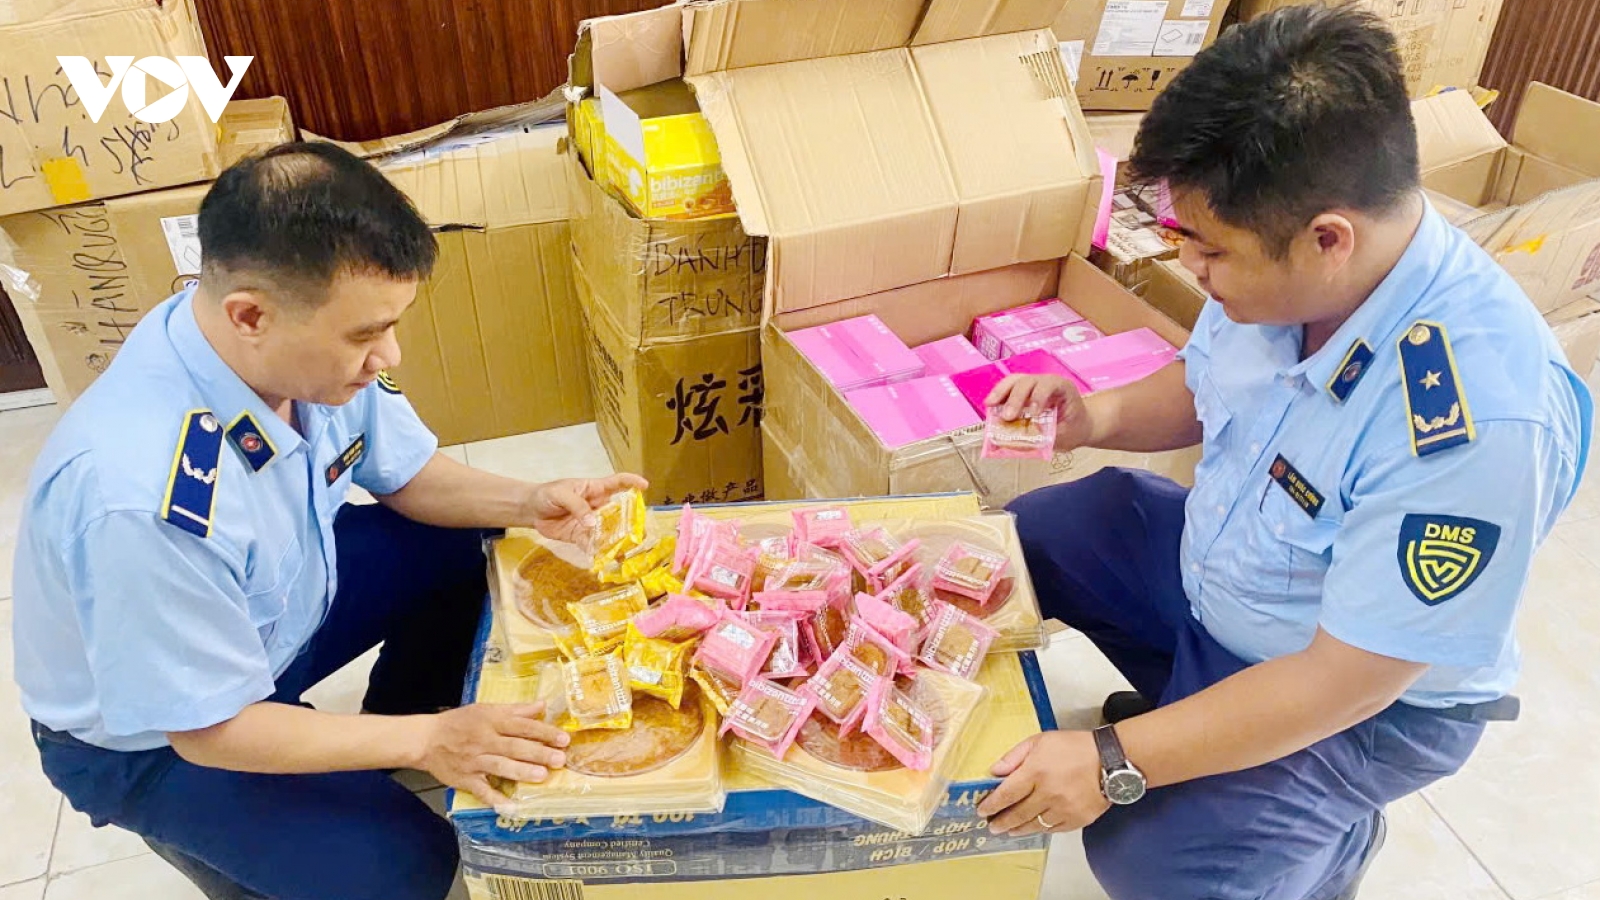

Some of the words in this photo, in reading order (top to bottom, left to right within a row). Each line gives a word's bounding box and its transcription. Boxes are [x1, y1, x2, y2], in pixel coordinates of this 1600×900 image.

[655, 234, 739, 277] BÁNH
[1424, 522, 1476, 544] DMS
[564, 840, 609, 849] Company
[933, 837, 969, 854] HỘP
[976, 836, 987, 848] 6
[592, 849, 638, 860] Management
[870, 845, 912, 862] BỊCH
[569, 864, 609, 876] 9001
[615, 863, 652, 875] ISO
